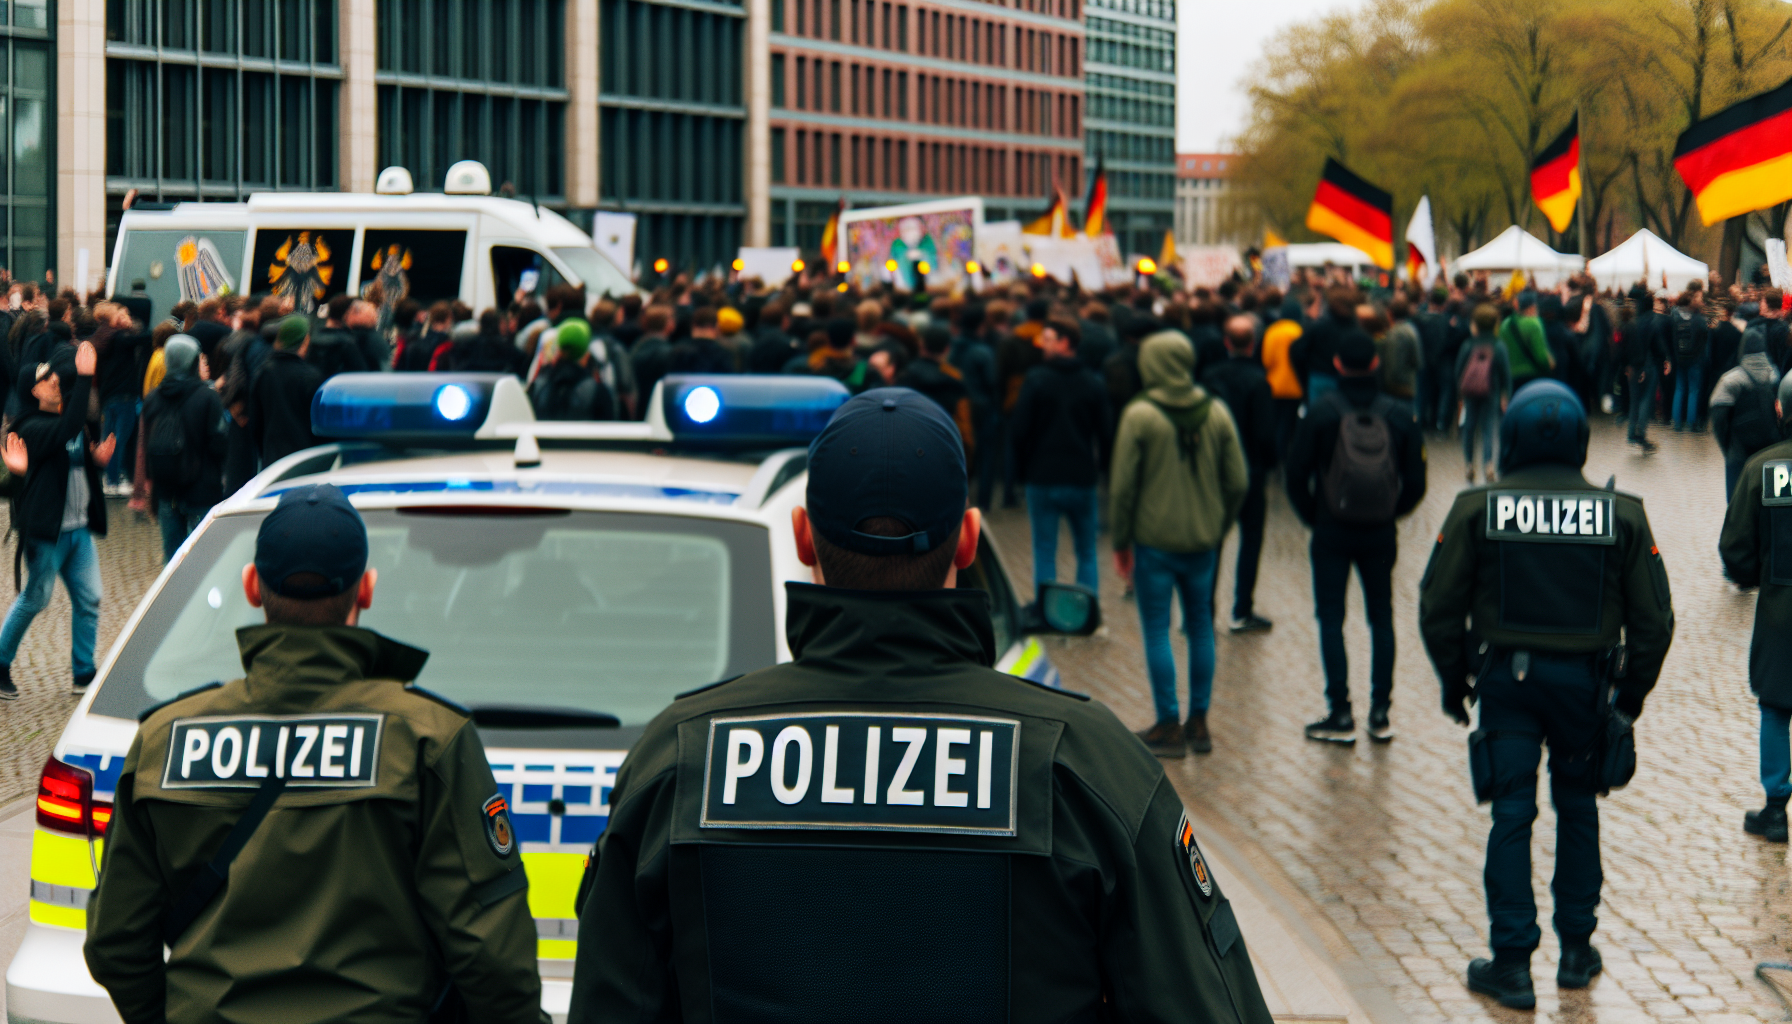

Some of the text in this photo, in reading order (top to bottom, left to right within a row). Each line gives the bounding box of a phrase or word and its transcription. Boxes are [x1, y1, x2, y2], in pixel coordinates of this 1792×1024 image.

[1773, 464, 1792, 498] P
[1496, 495, 1604, 535] POLIZEI
[181, 725, 365, 779] POLIZEI
[722, 725, 993, 809] POLIZEI
